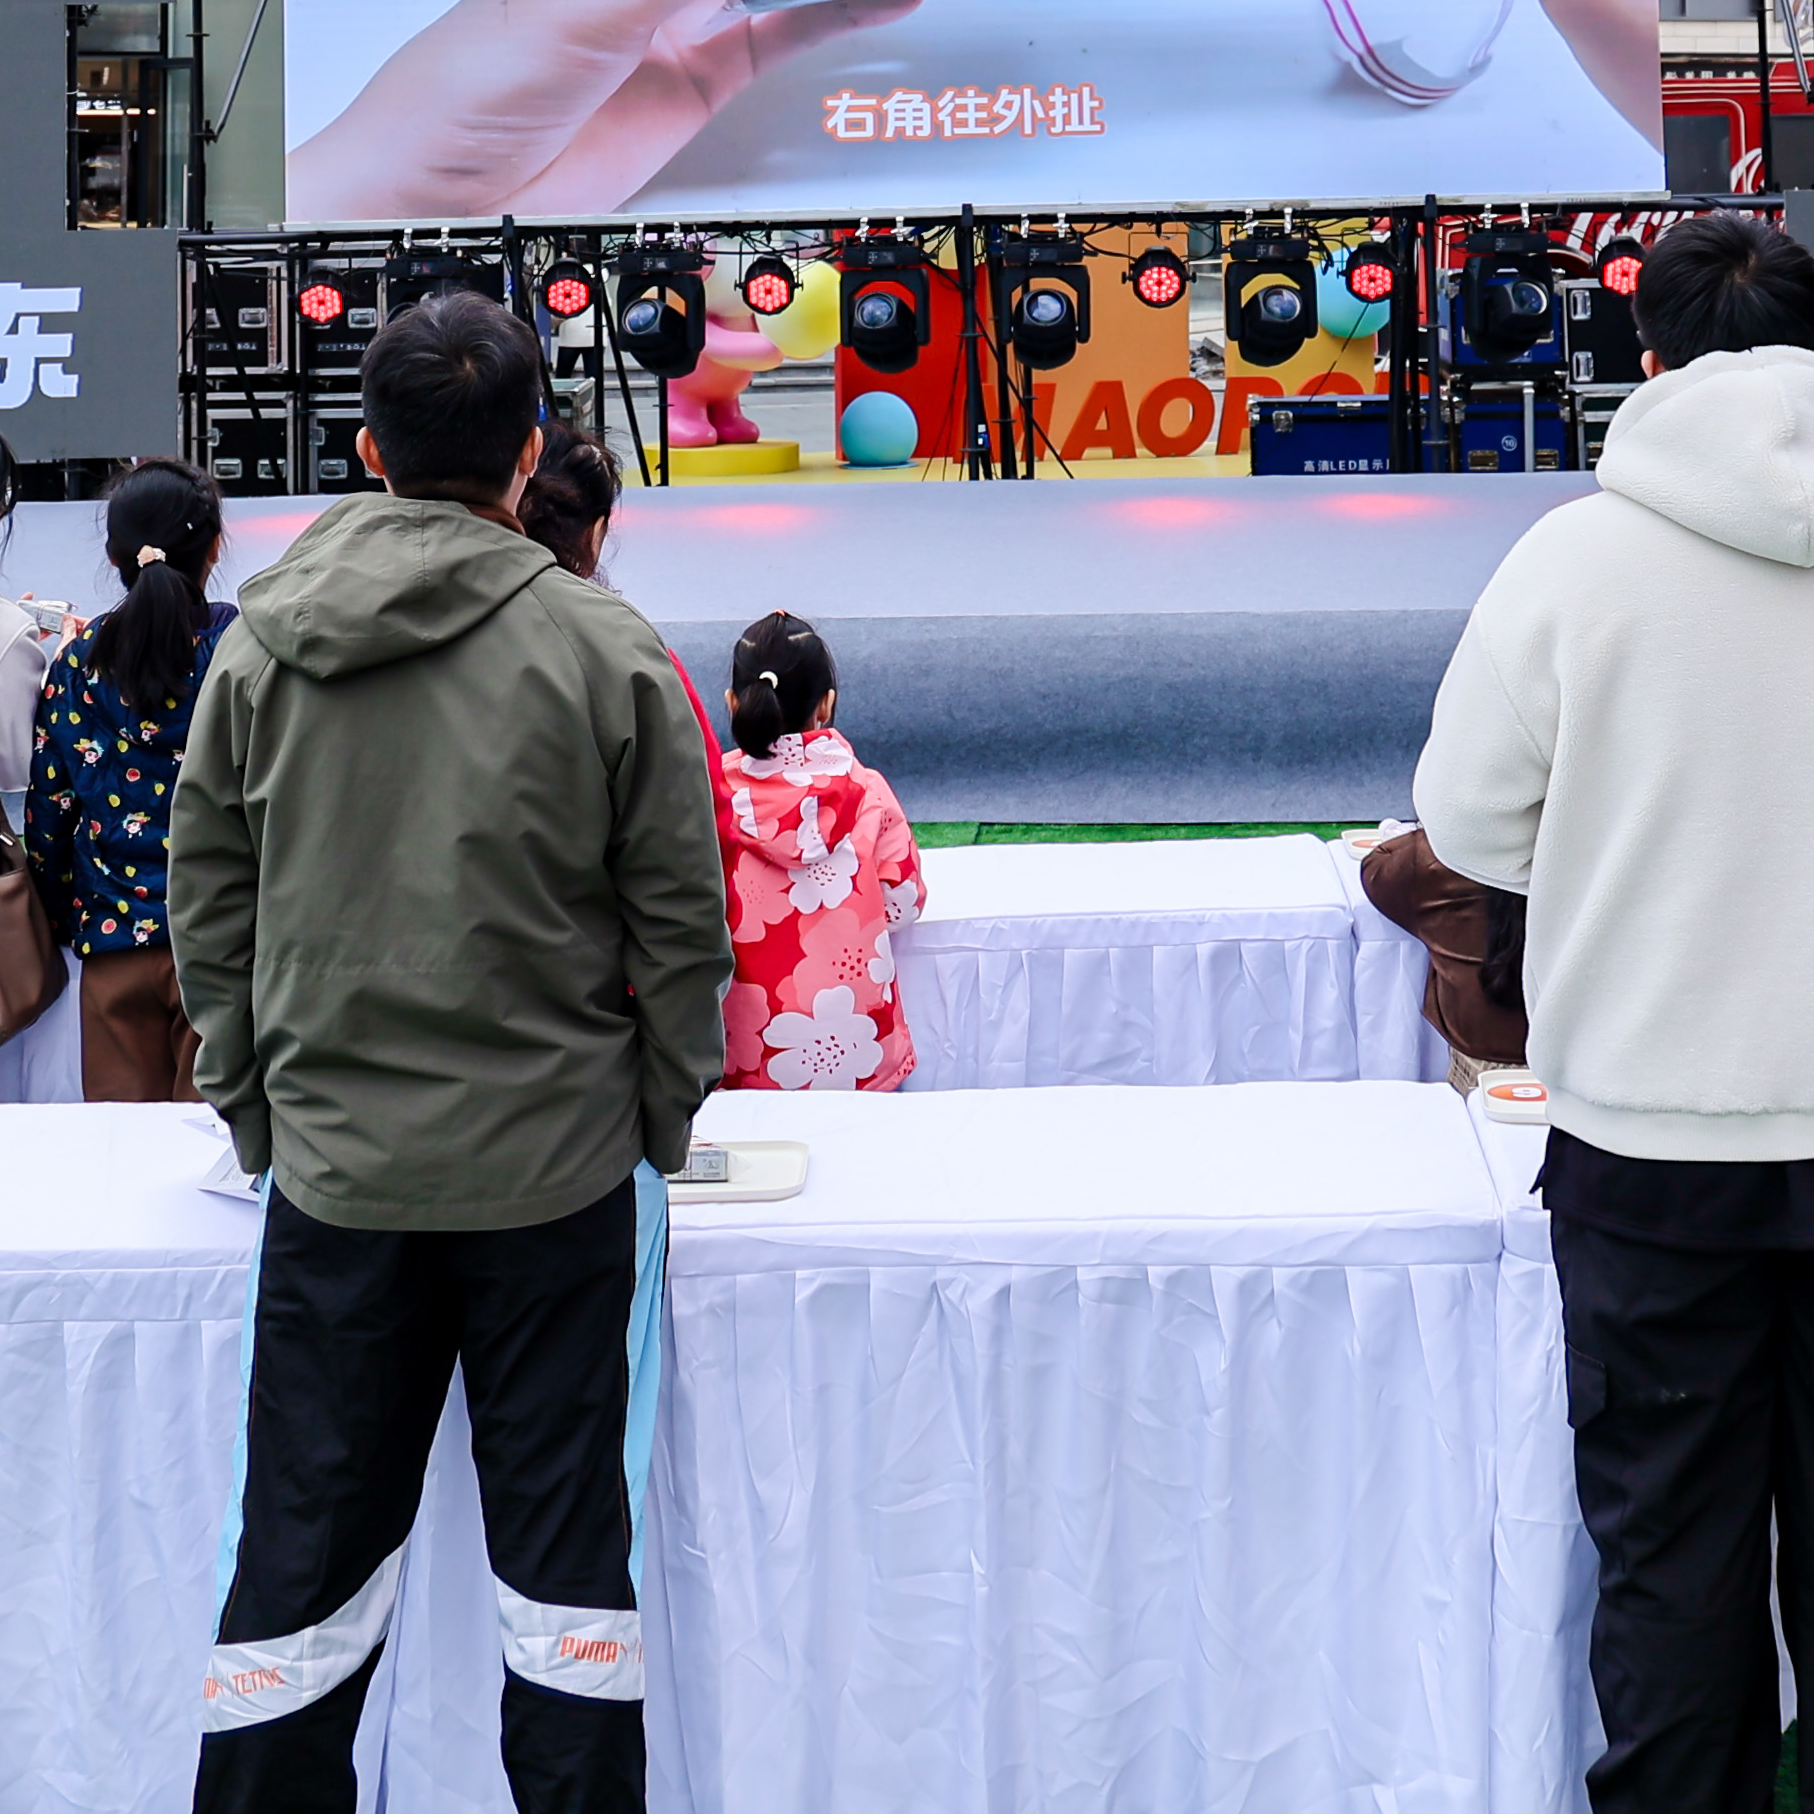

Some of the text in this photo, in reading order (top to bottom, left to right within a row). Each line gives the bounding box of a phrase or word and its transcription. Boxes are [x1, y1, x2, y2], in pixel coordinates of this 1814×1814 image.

[823, 85, 1104, 139] 右角往外扯
[559, 1635, 626, 1665] PUMA
